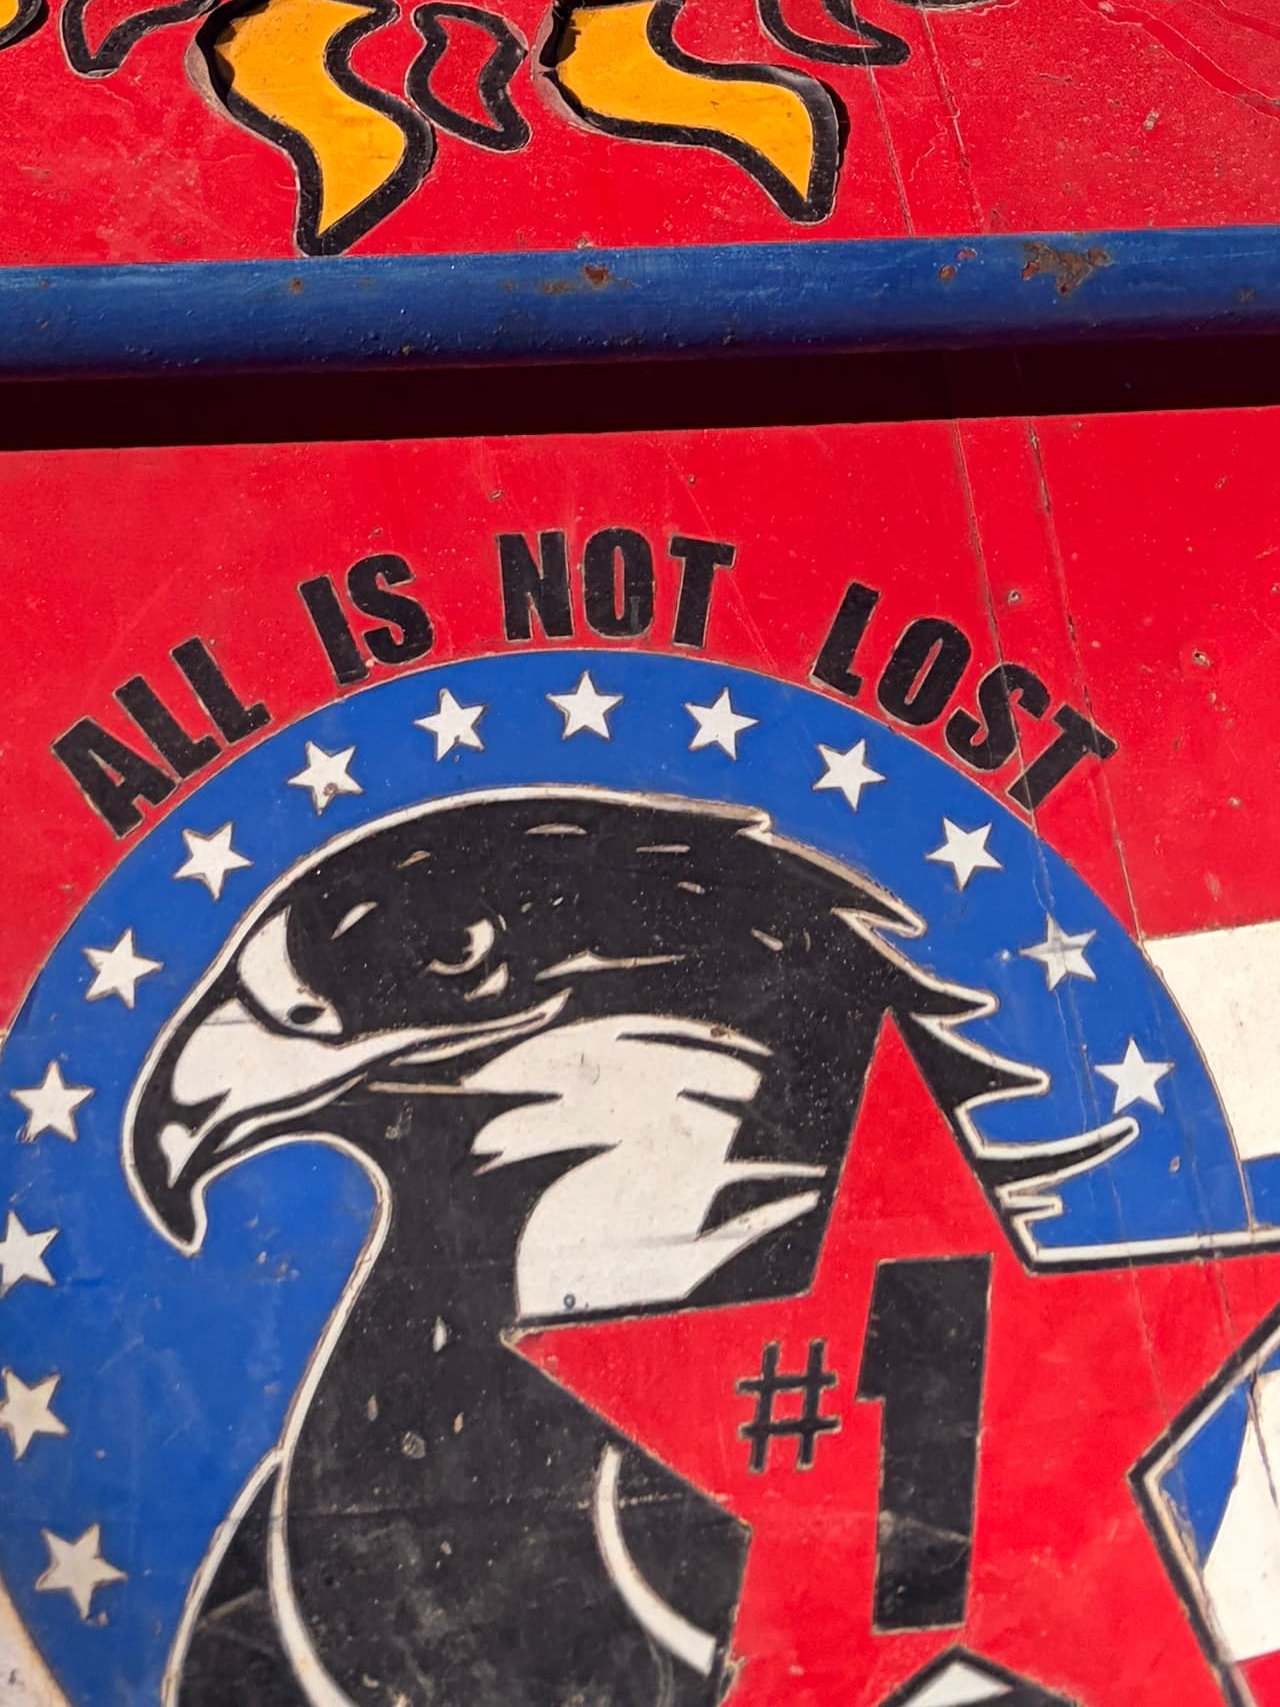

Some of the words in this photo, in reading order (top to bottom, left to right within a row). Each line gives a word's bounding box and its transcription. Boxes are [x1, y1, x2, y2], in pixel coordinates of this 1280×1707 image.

[50, 633, 273, 840] ALL
[296, 552, 436, 686] IS
[496, 526, 737, 648] NOT
[809, 581, 1118, 813] LOST
